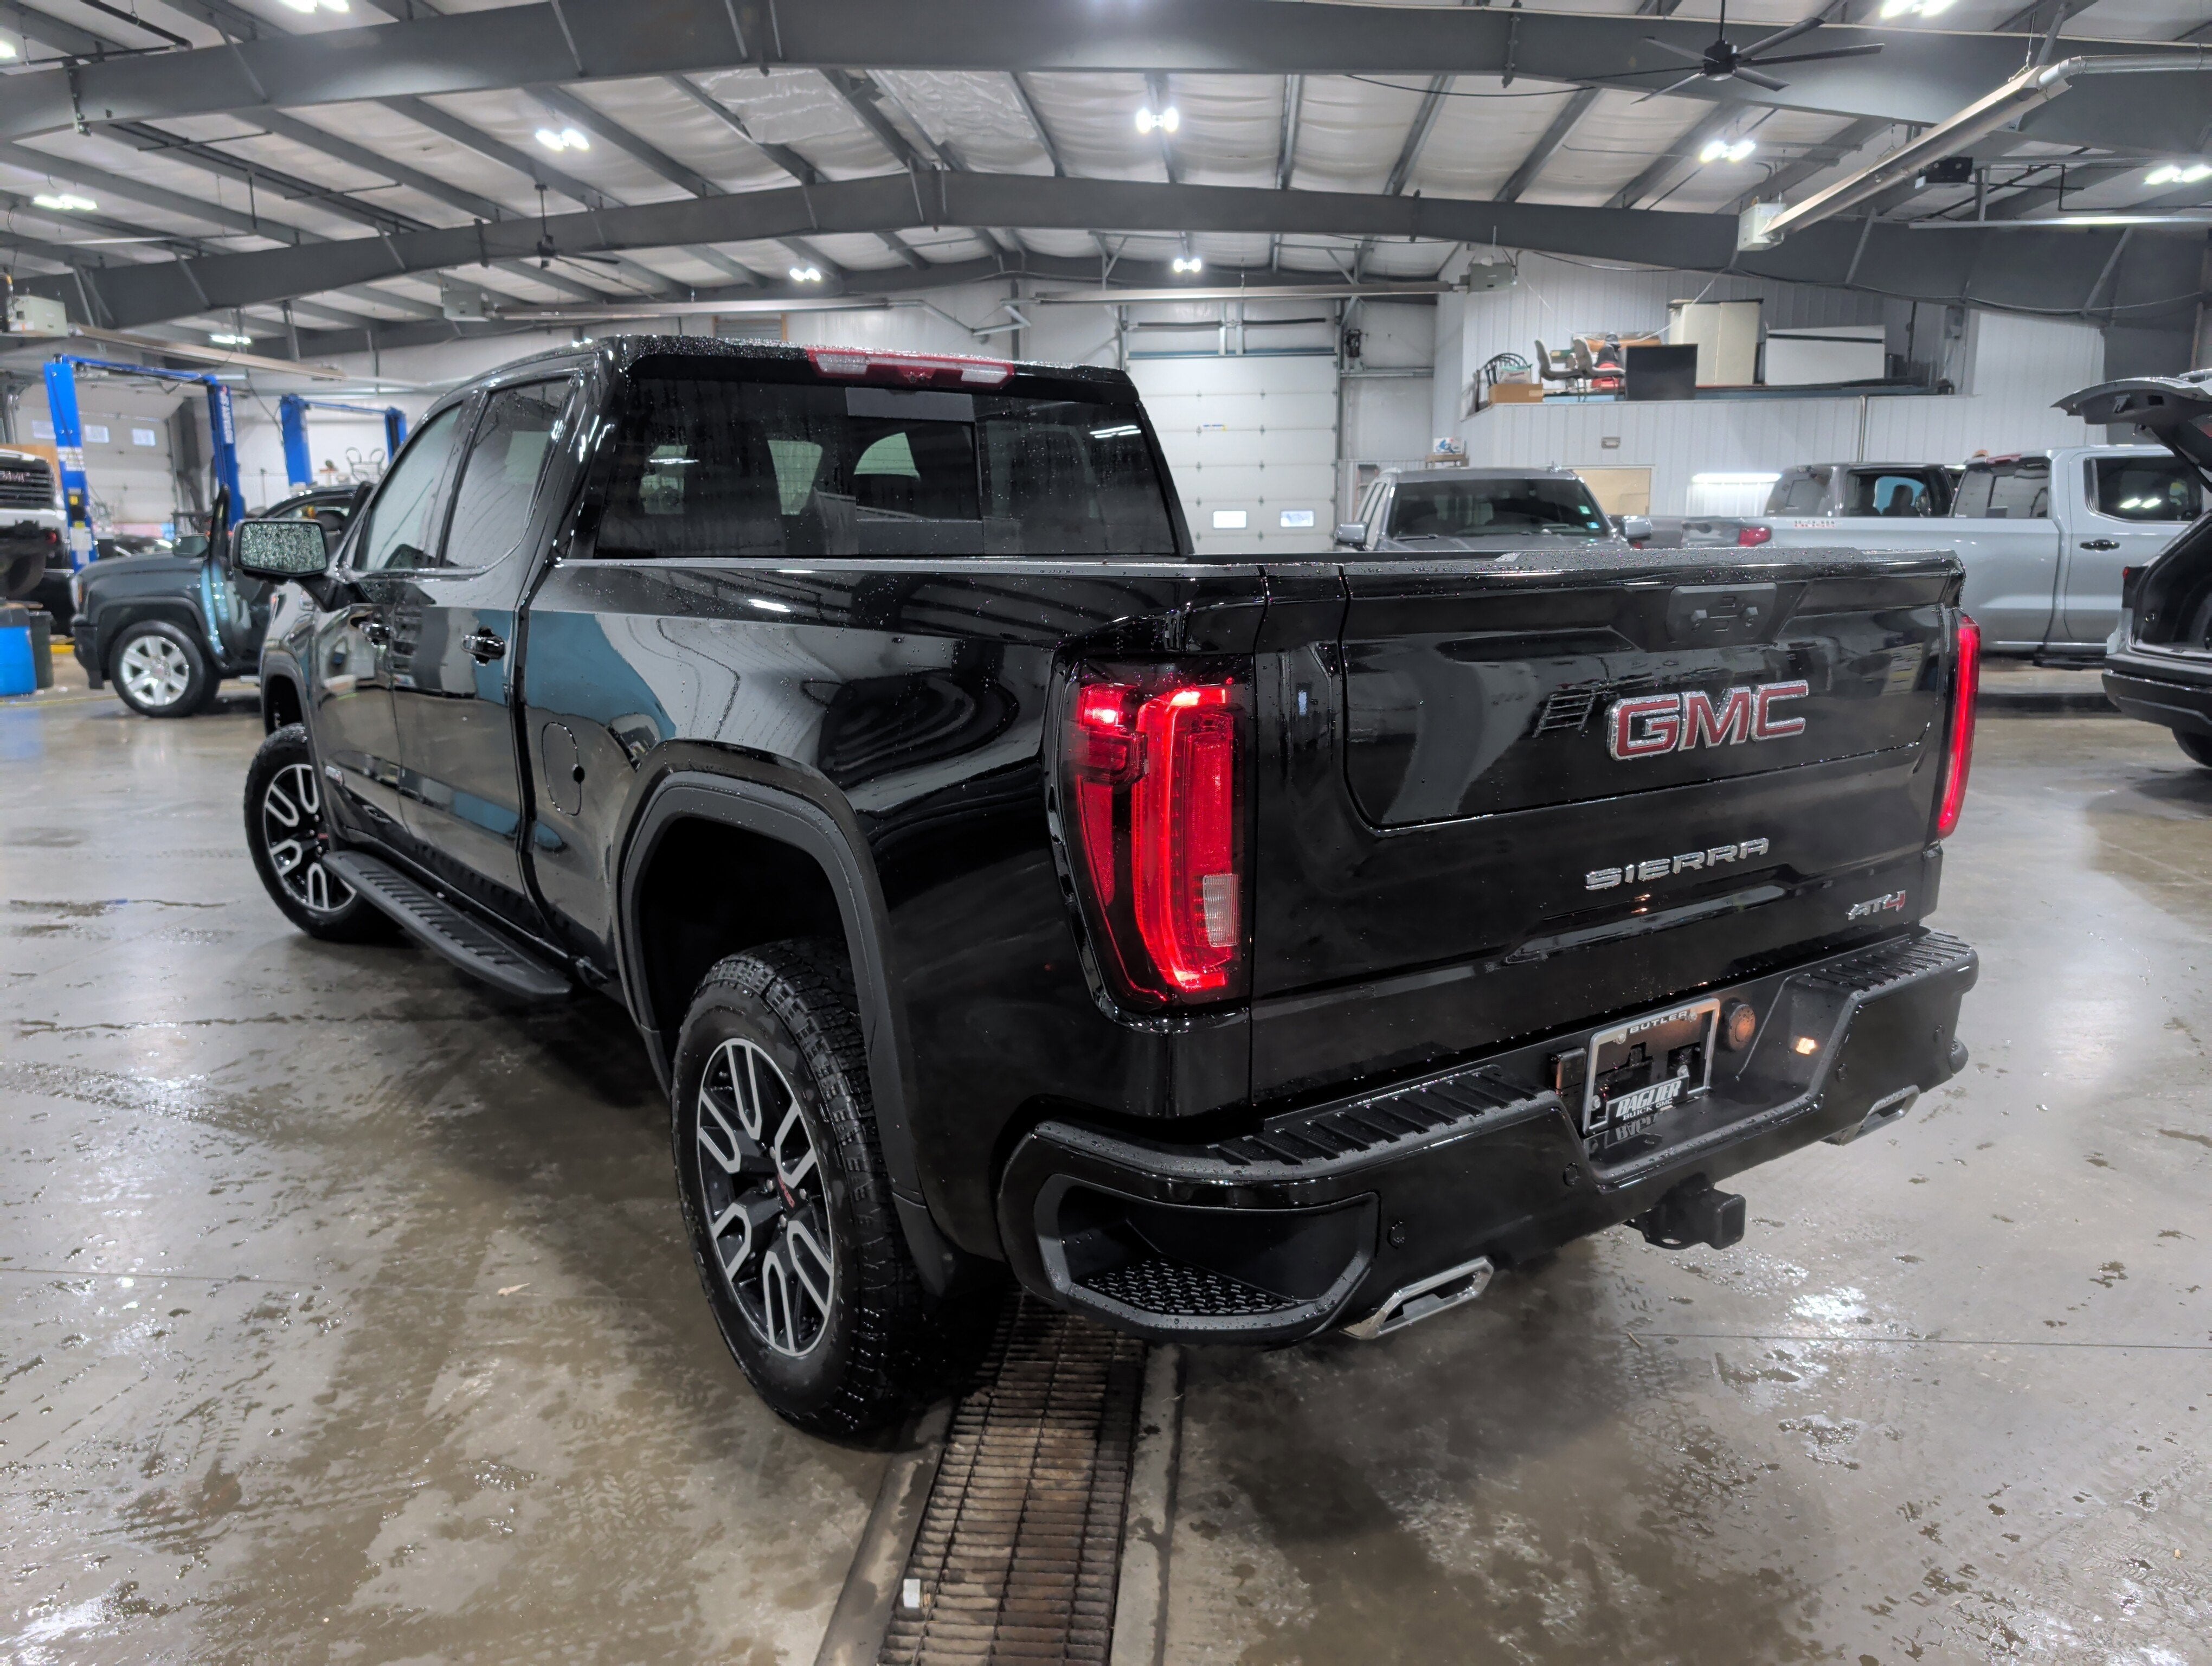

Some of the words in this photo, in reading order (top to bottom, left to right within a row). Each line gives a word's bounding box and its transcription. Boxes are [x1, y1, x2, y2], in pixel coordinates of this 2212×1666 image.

[1605, 680, 1809, 760] GMC
[1584, 837, 1769, 890] SIERRA
[1846, 889, 1906, 920] AT4
[1629, 1010, 1688, 1034] BUTLER
[1615, 1080, 1682, 1118] BAGLIER
[1623, 1106, 1653, 1121] BUICK
[1656, 1099, 1673, 1108] GMC
